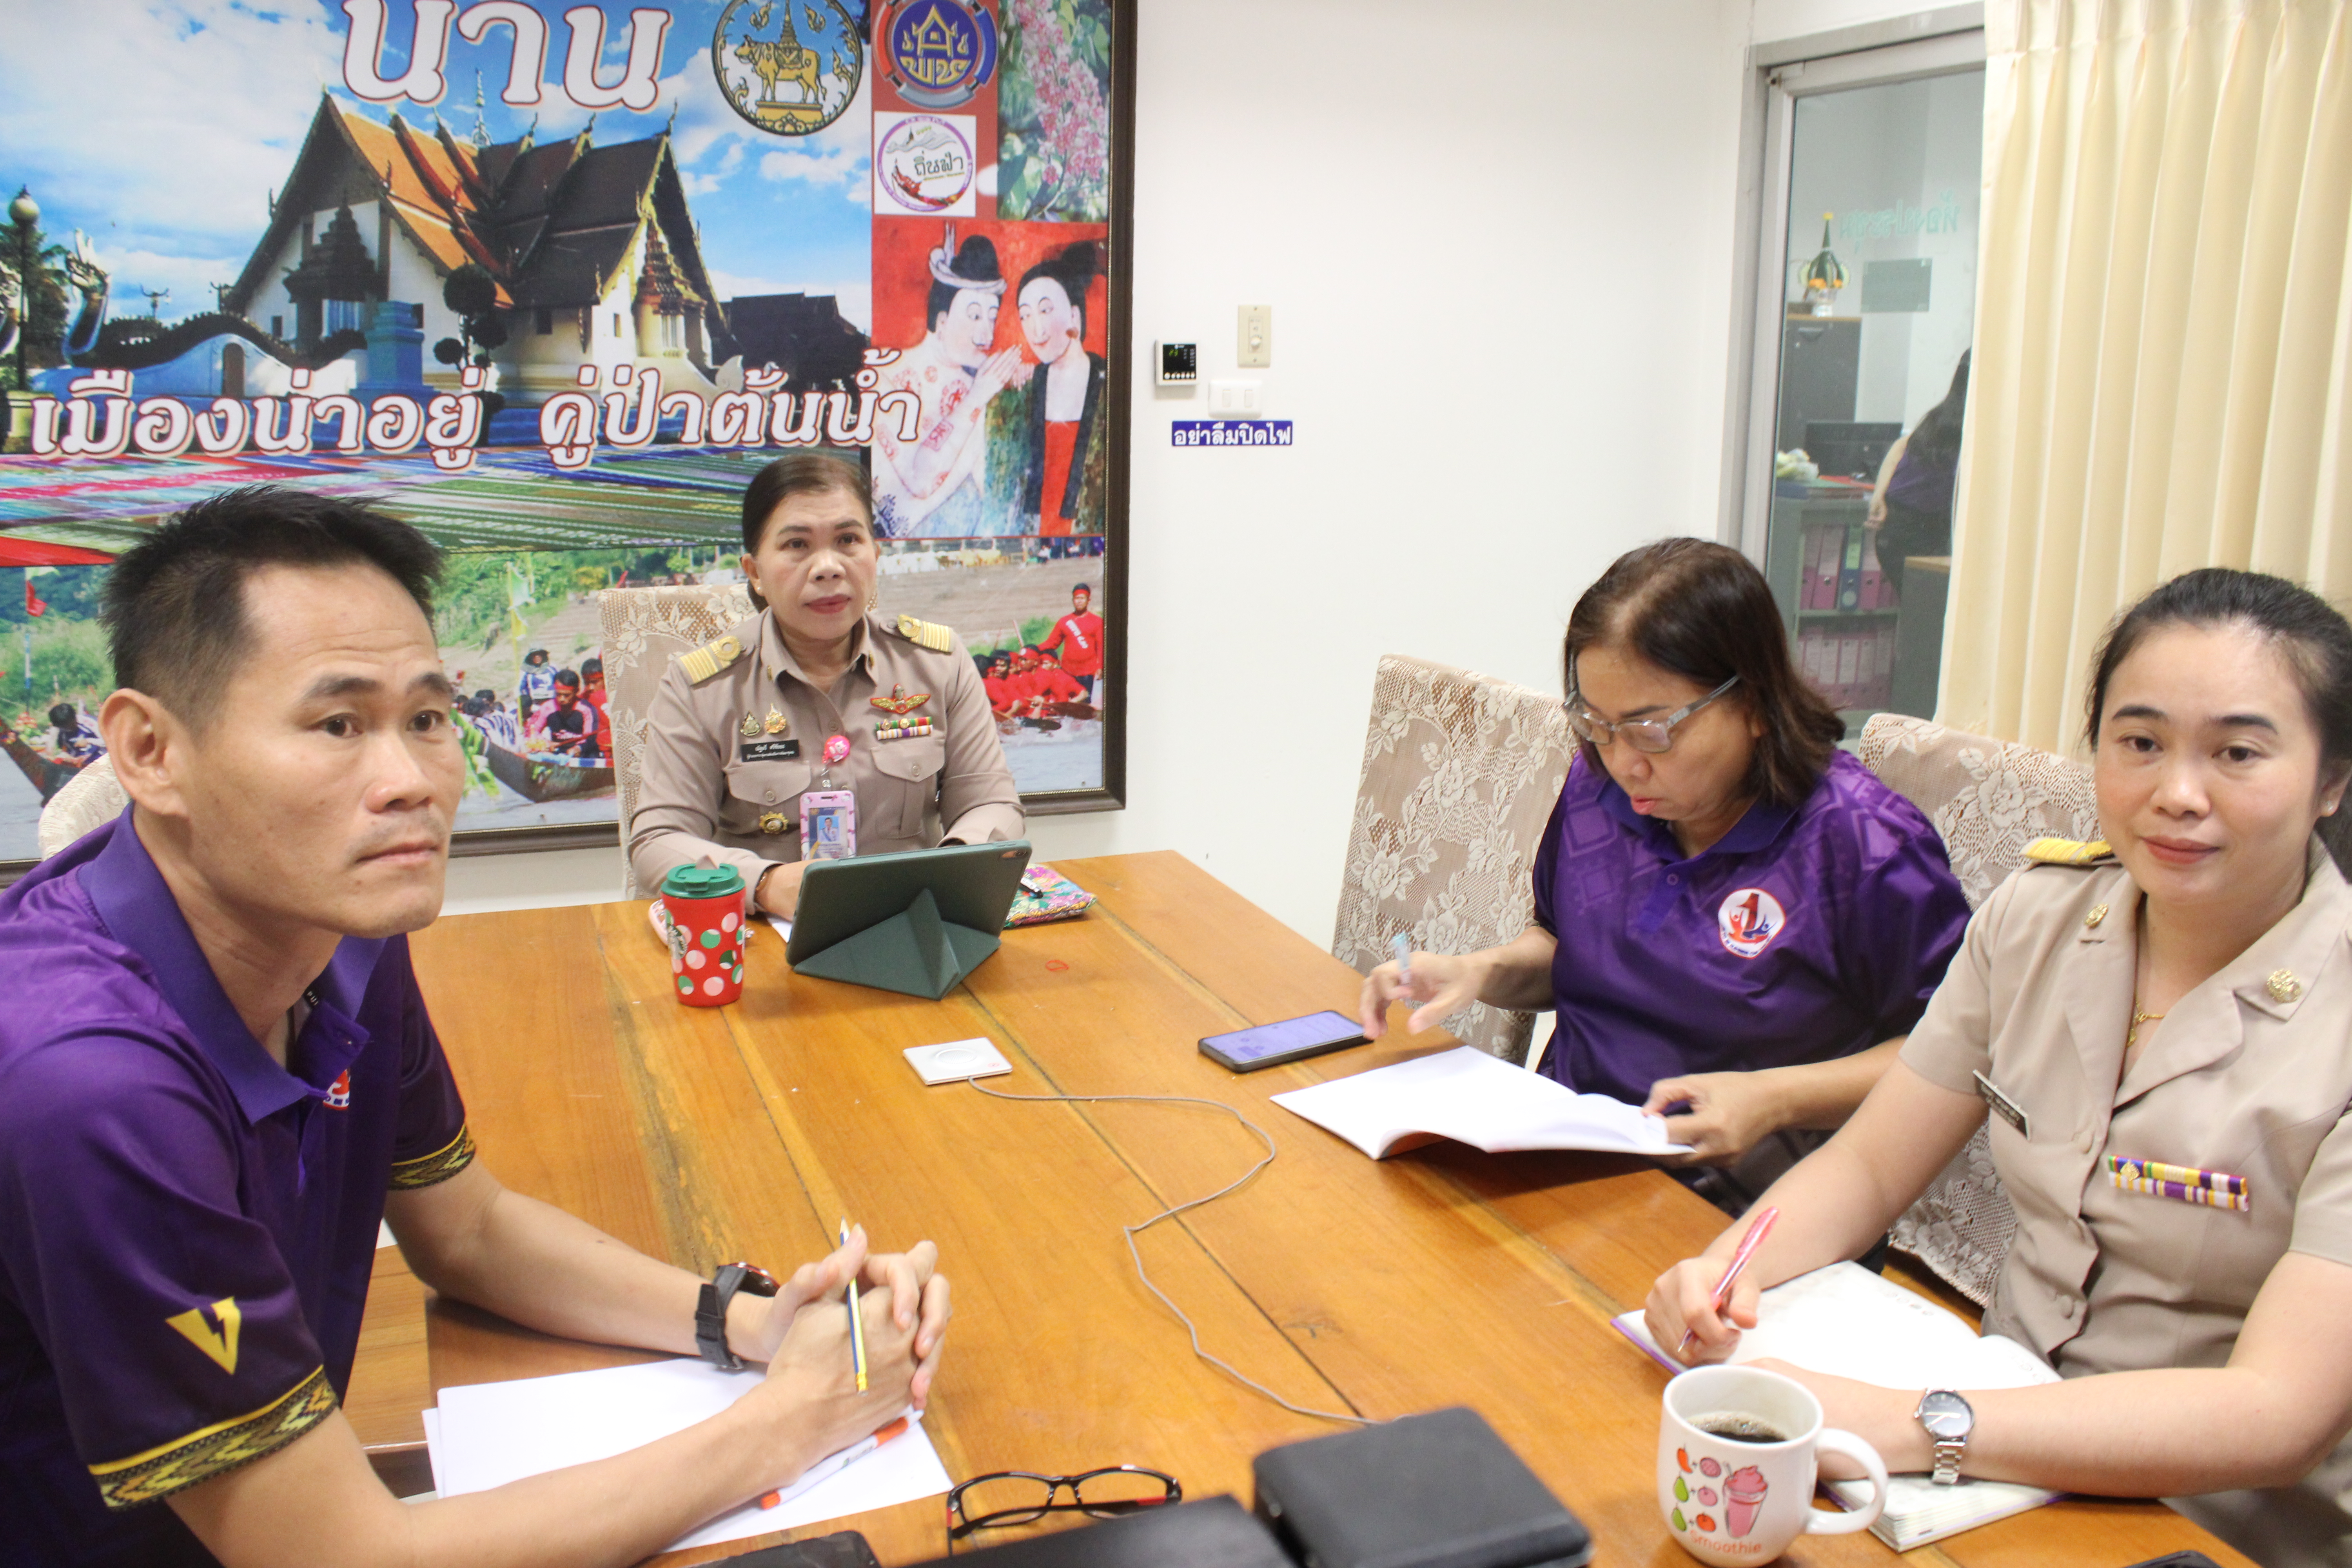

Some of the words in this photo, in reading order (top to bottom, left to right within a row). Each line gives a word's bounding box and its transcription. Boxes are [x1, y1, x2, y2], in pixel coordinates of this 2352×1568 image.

[30, 367, 485, 472] เมืองน่าอยู่
[538, 348, 922, 470] คู่ป่าต้นน้ำ
[1174, 422, 1291, 445] อย่าลืมปิดไฟ
[1689, 1530, 1762, 1555] Smoothie
